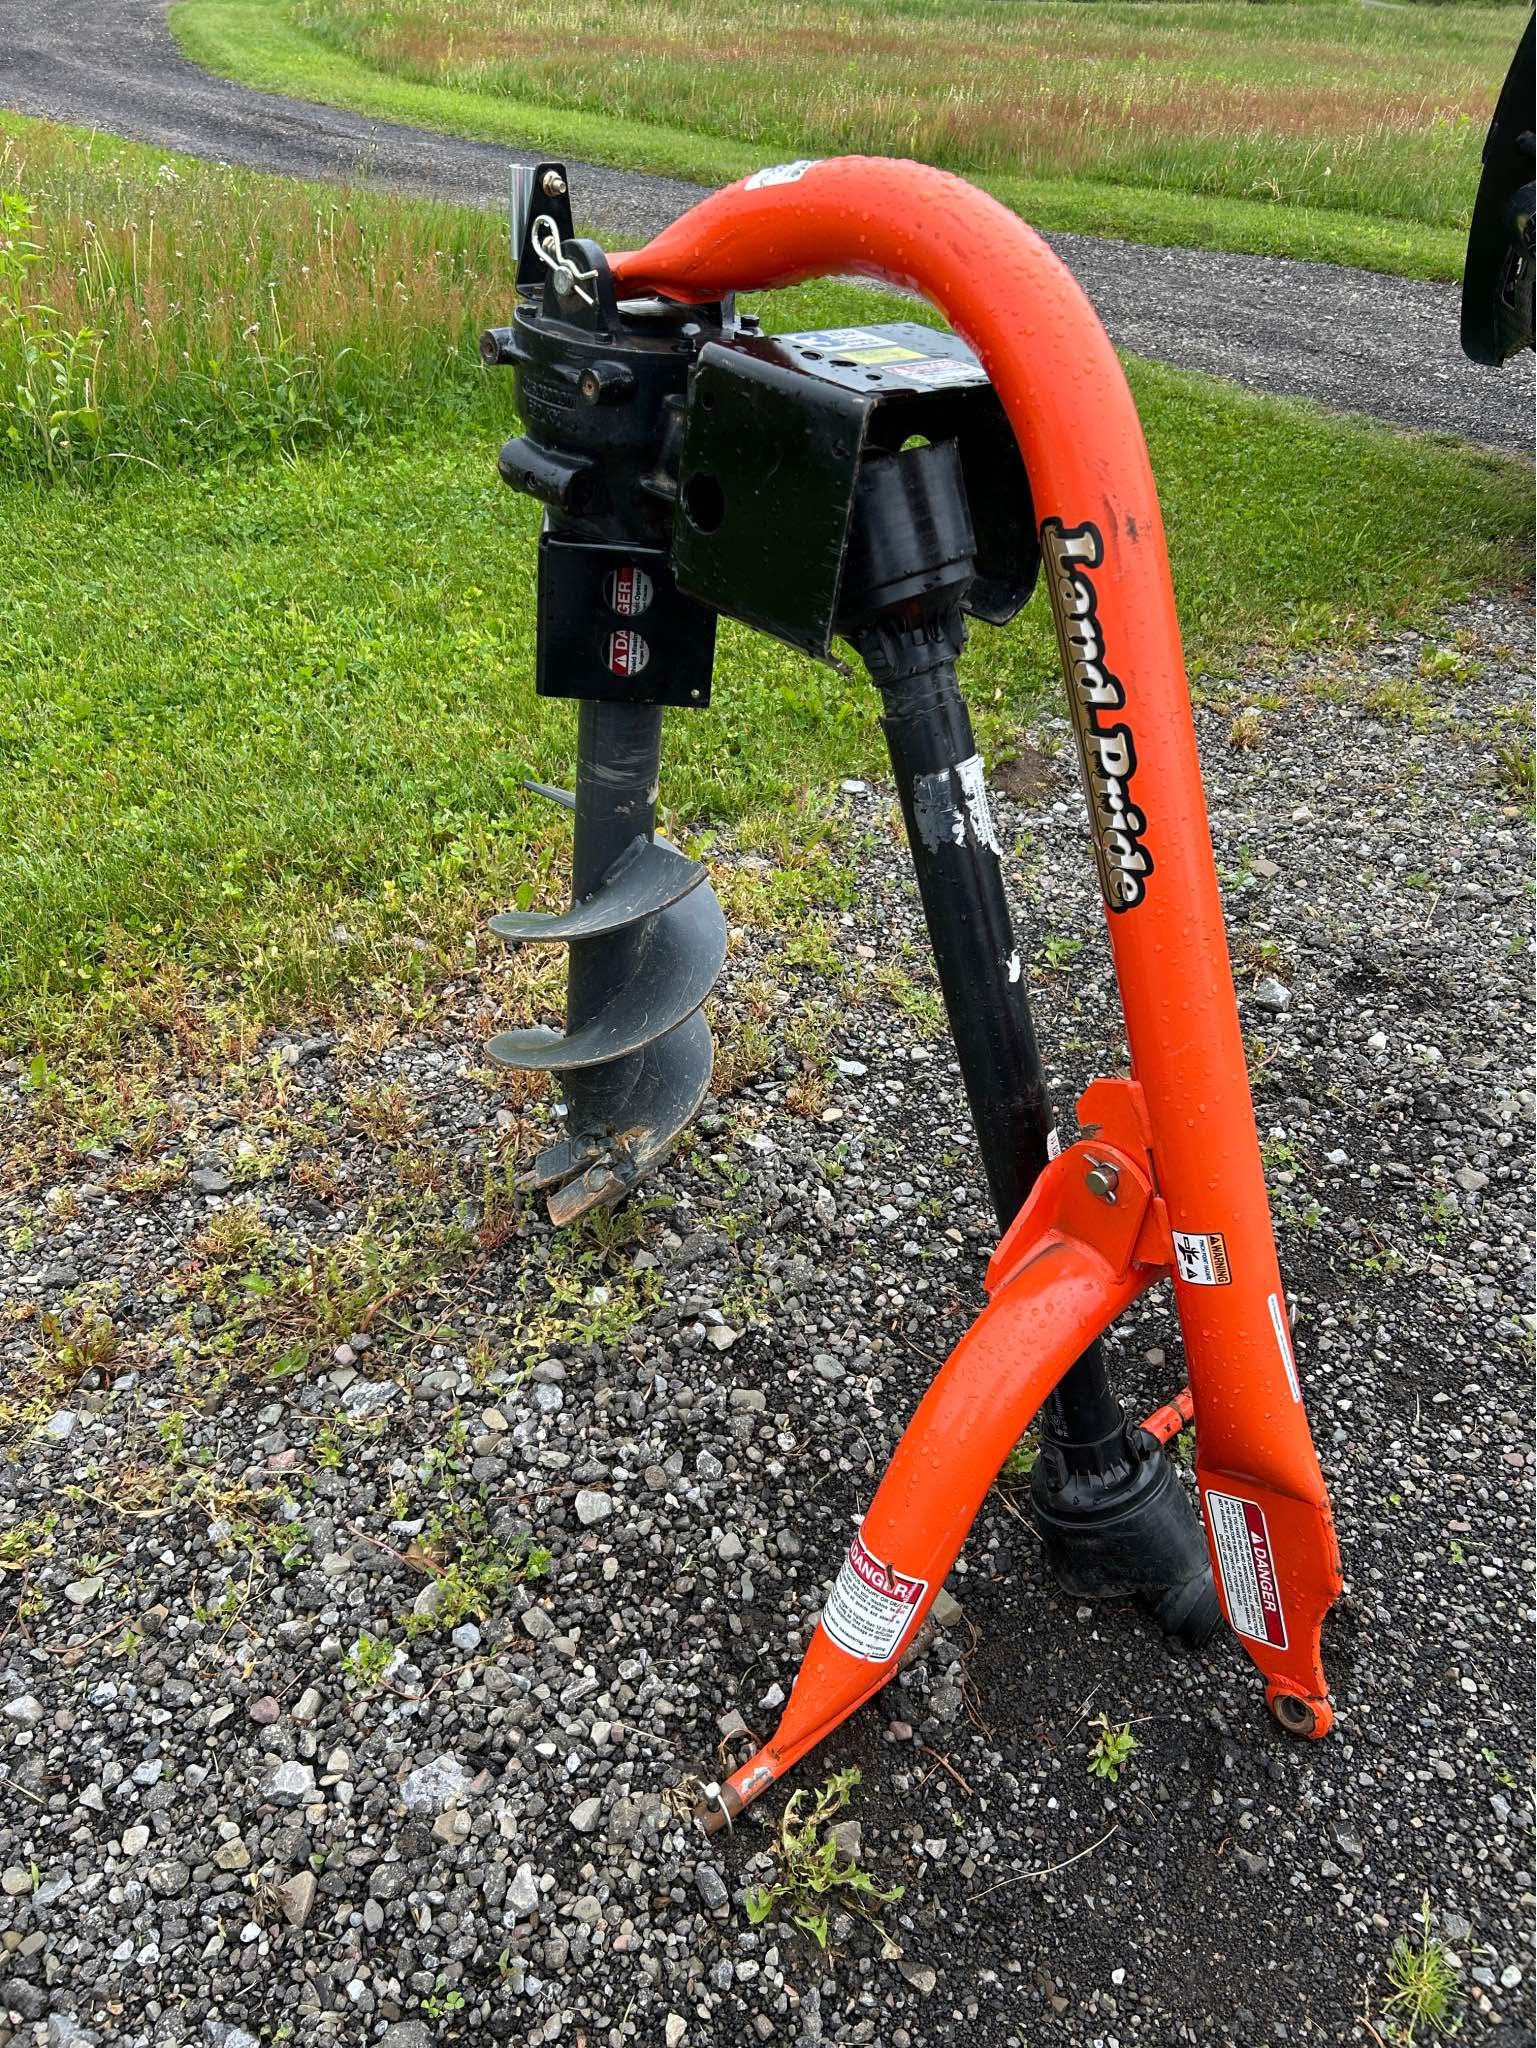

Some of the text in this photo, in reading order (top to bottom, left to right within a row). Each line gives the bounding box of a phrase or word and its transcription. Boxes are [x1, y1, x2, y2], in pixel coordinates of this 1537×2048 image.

[1043, 520, 1148, 907] Land Pride
[1211, 1244, 1228, 1282] WARNING
[1228, 1552, 1236, 1574] CONTACT
[1242, 1563, 1251, 1594] UNDERSTOOD
[1246, 1551, 1254, 1578] IMPLEMENT
[860, 1582, 879, 1598] INJURY
[1254, 1546, 1276, 1612] DANGER
